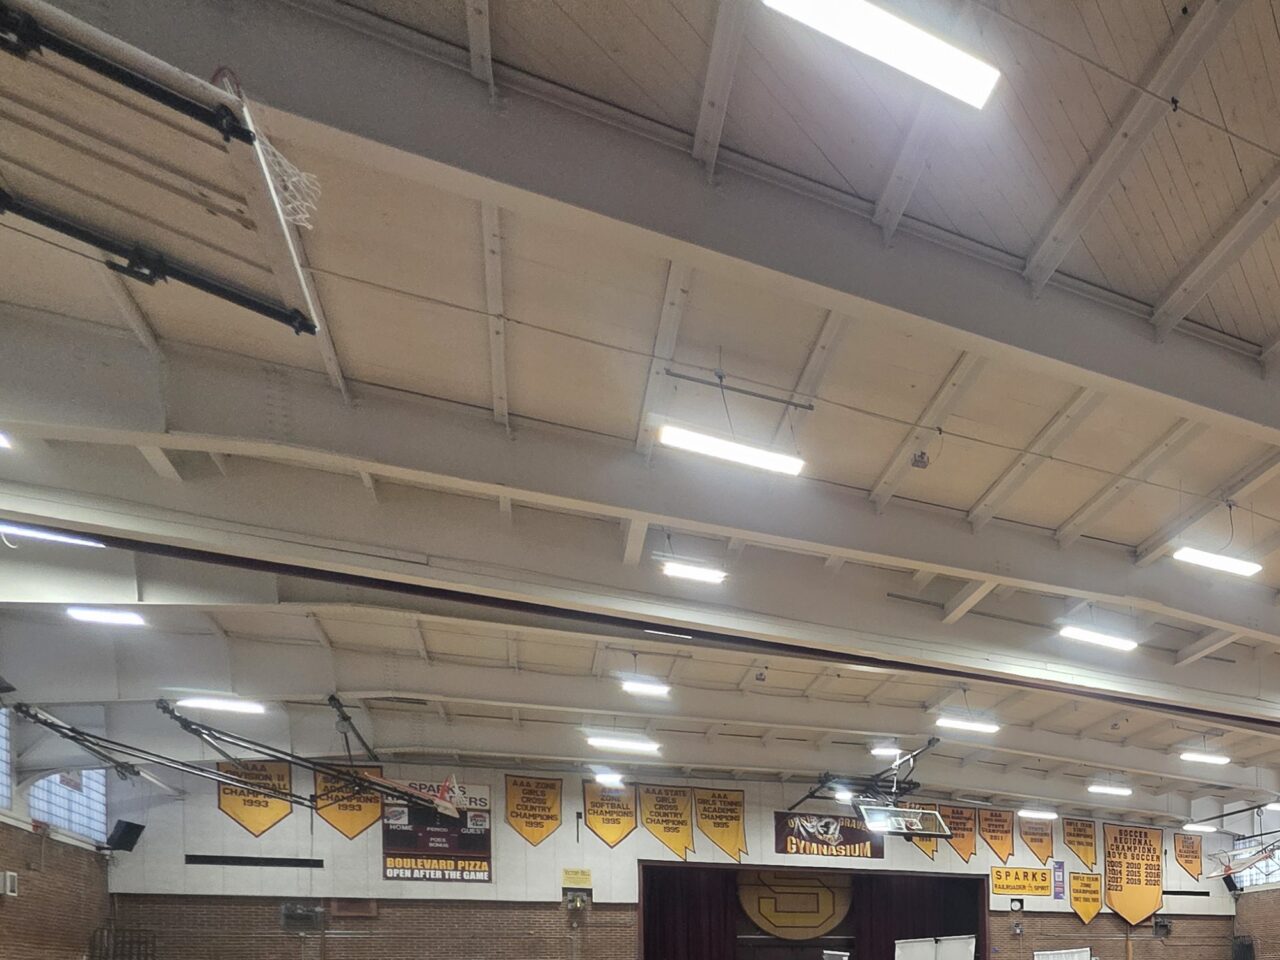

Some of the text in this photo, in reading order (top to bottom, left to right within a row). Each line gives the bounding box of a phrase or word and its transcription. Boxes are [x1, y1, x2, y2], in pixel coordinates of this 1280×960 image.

[242, 798, 269, 808] 1993
[337, 803, 362, 811] 1993
[590, 801, 631, 810] SOFTBALL
[515, 804, 553, 813] COUNTRY
[702, 806, 738, 814] ACADEMIC
[510, 811, 559, 821] CHAMPIONS
[587, 809, 634, 818] CHAMPIONS
[649, 810, 683, 819] COUNTRY
[700, 813, 740, 821] CHAMPIONS
[601, 817, 621, 825] 1995
[645, 817, 688, 826] CHAMPIONS
[1119, 829, 1149, 838] SOCCER
[1113, 836, 1153, 846] REGIONAL
[787, 836, 871, 857] GYMNASIUM
[1110, 844, 1157, 854] CHAMPIONS
[1131, 853, 1160, 862] SOCCER
[386, 857, 489, 871] BOULEVARD PIZZA
[1145, 863, 1160, 871] 2012
[386, 868, 489, 880] OPEN AFTER THE GAME
[995, 870, 1047, 881] SPARKS
